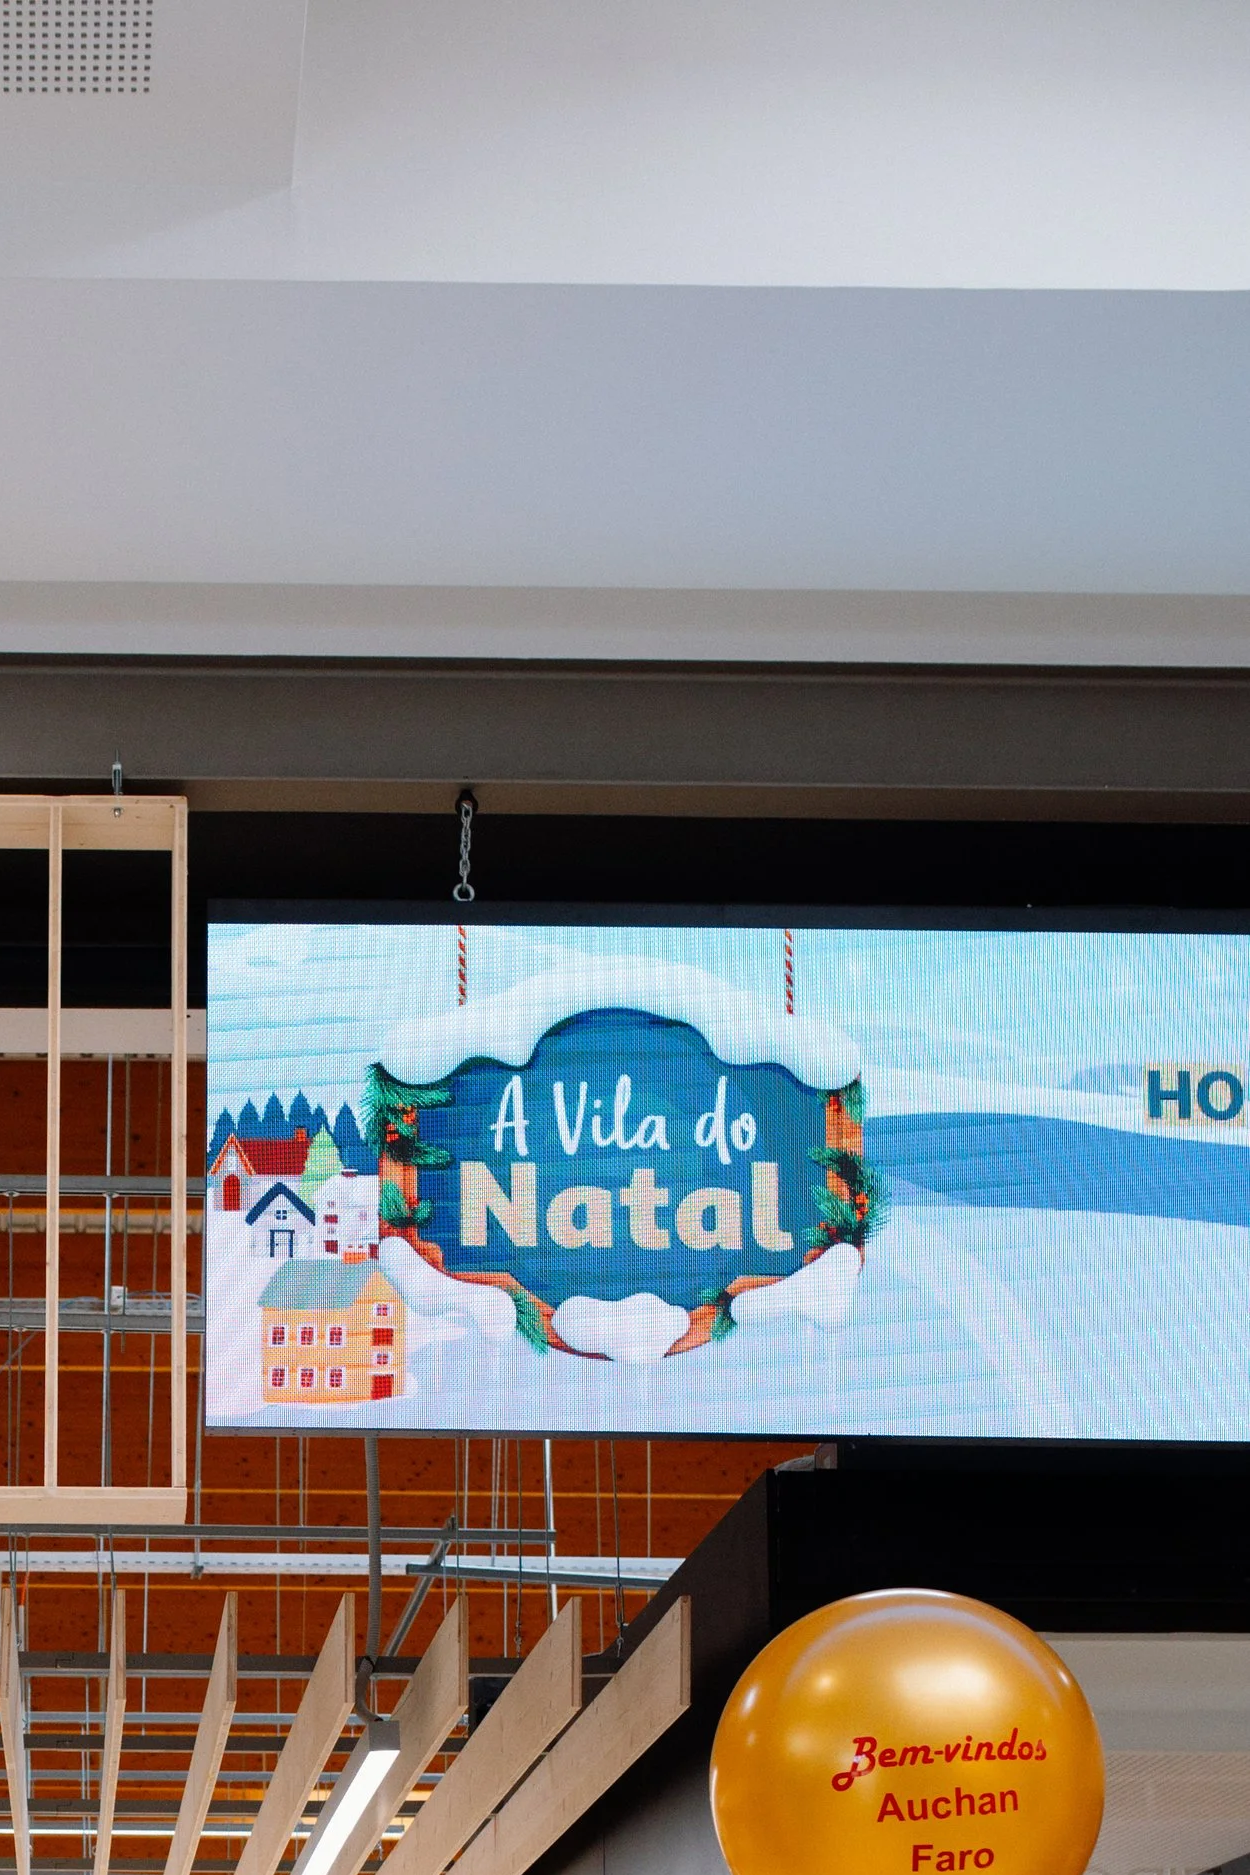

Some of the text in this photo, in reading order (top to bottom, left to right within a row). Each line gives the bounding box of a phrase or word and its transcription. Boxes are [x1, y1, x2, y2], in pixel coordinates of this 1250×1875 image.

[490, 1074, 756, 1165] A Vila do
[460, 1161, 794, 1251] Natal
[831, 1727, 1047, 1792] Bem-vindos
[877, 1787, 1018, 1823] Auchan
[912, 1844, 994, 1872] Faro
